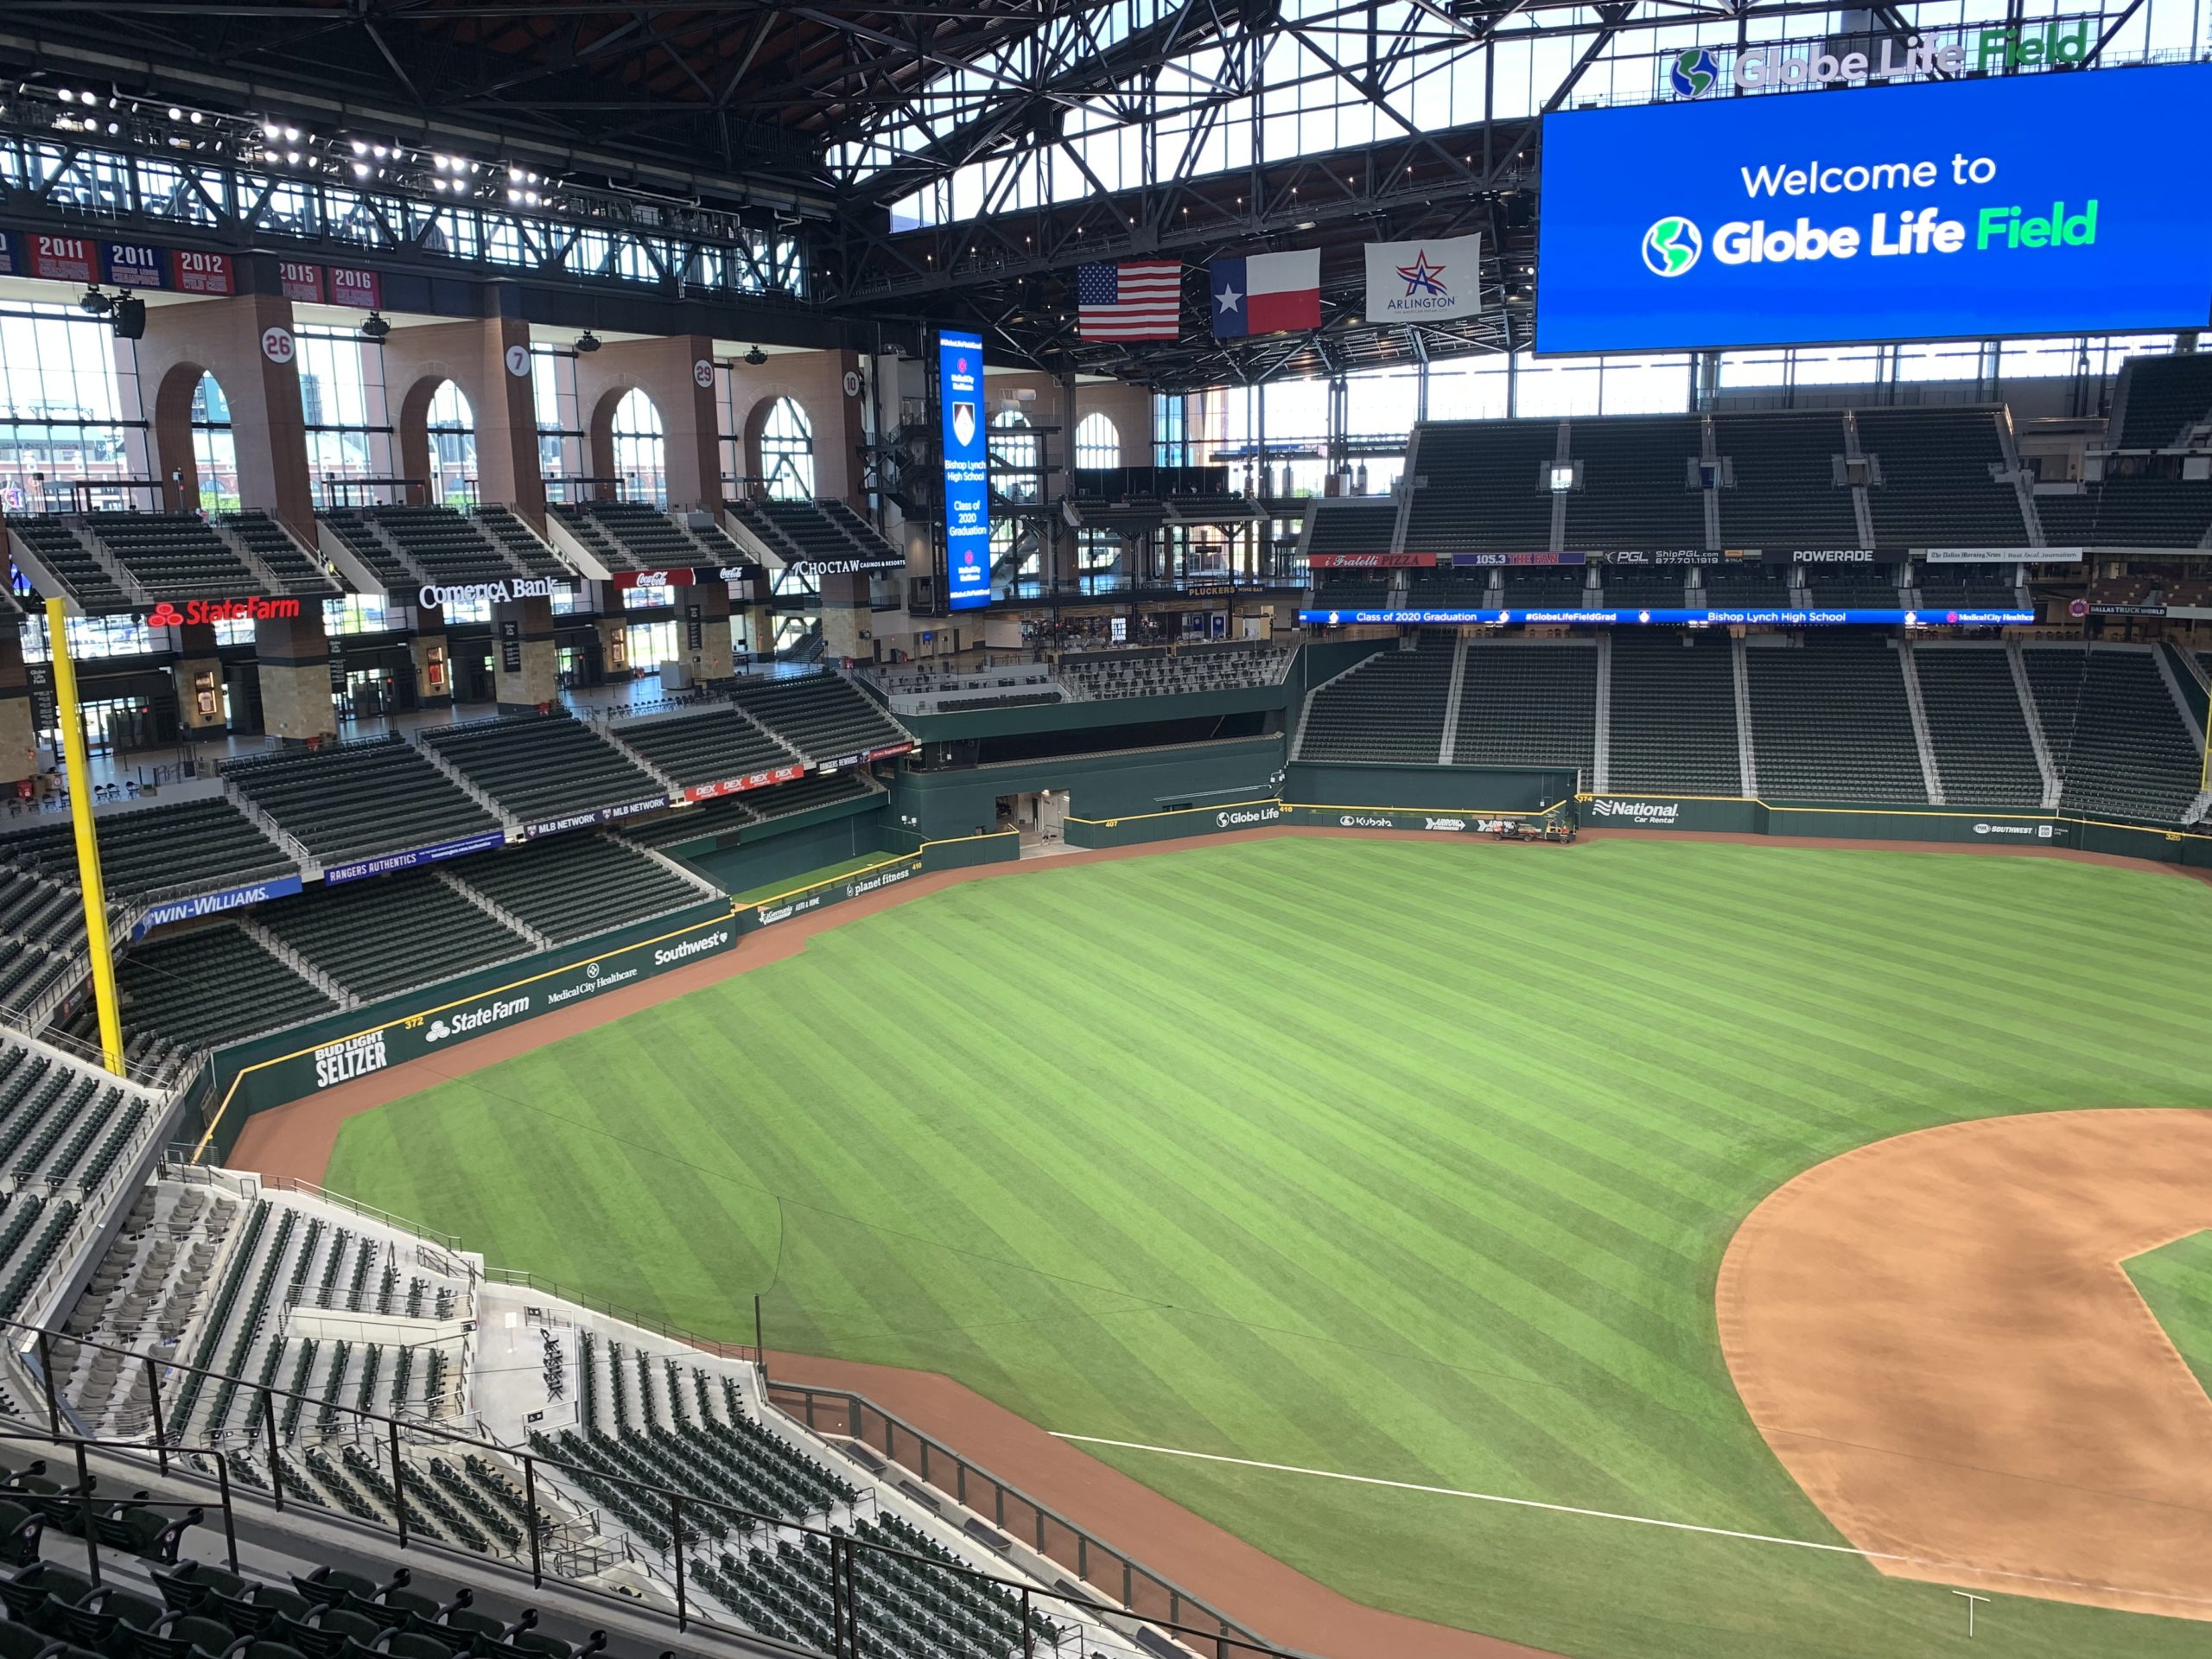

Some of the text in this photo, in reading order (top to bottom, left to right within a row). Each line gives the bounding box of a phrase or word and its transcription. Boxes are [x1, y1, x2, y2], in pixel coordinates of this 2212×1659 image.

[1732, 20, 2088, 89] Globe Life Field
[1741, 152, 1996, 198] Welcome to
[1713, 199, 2098, 264] Globe Life Field
[39, 236, 83, 258] 2011
[112, 245, 154, 267] 2011
[181, 252, 223, 273] 2012
[336, 269, 372, 289] 2016
[1388, 297, 1455, 309] ARLINGTON
[266, 334, 291, 355] 26
[513, 352, 523, 371] 7
[696, 366, 711, 382] 29
[847, 377, 857, 392] 10
[944, 460, 987, 471] Bishop Lynch
[947, 472, 984, 483] High School
[954, 500, 981, 511] Class of
[958, 513, 977, 524] 2020
[950, 526, 987, 537] Graduation
[1476, 553, 1560, 565] 105.3 THE FAN
[1617, 551, 1649, 562] PGL
[1656, 550, 1719, 558] ShipPGL.com
[1793, 550, 1874, 562] POWERADE
[799, 560, 861, 575] CHOCTAW
[1332, 556, 1378, 567] Fratelli
[1382, 556, 1420, 566] PIZZA
[512, 575, 558, 598] Bank
[1189, 586, 1236, 596] PLUCKERS
[1357, 612, 1477, 621] Class of 2020 Graduation
[1526, 612, 1617, 622] #GlobeLifeFieldGrad
[1707, 612, 1846, 623] Bishop Lynch High School
[1988, 613, 2002, 623] City
[750, 773, 768, 784] DEX
[775, 767, 793, 779] DEX
[696, 784, 716, 796] DEX
[723, 779, 743, 790] DEX
[613, 798, 664, 817] MLB NETWORK
[1230, 808, 1280, 823] Globe Life
[538, 813, 596, 834] MLB NETWORK
[1356, 817, 1393, 828] Kubota
[2165, 833, 2181, 842] 326
[330, 854, 417, 882] RANGERS AUTHENTICS
[855, 869, 909, 896] planet fitness
[655, 936, 718, 965] Southwest
[548, 968, 638, 1004] Medical City Healthcare
[404, 1017, 424, 1030] 372
[315, 1031, 385, 1061] BUD LIGHT
[316, 1041, 387, 1088] SELTZER
